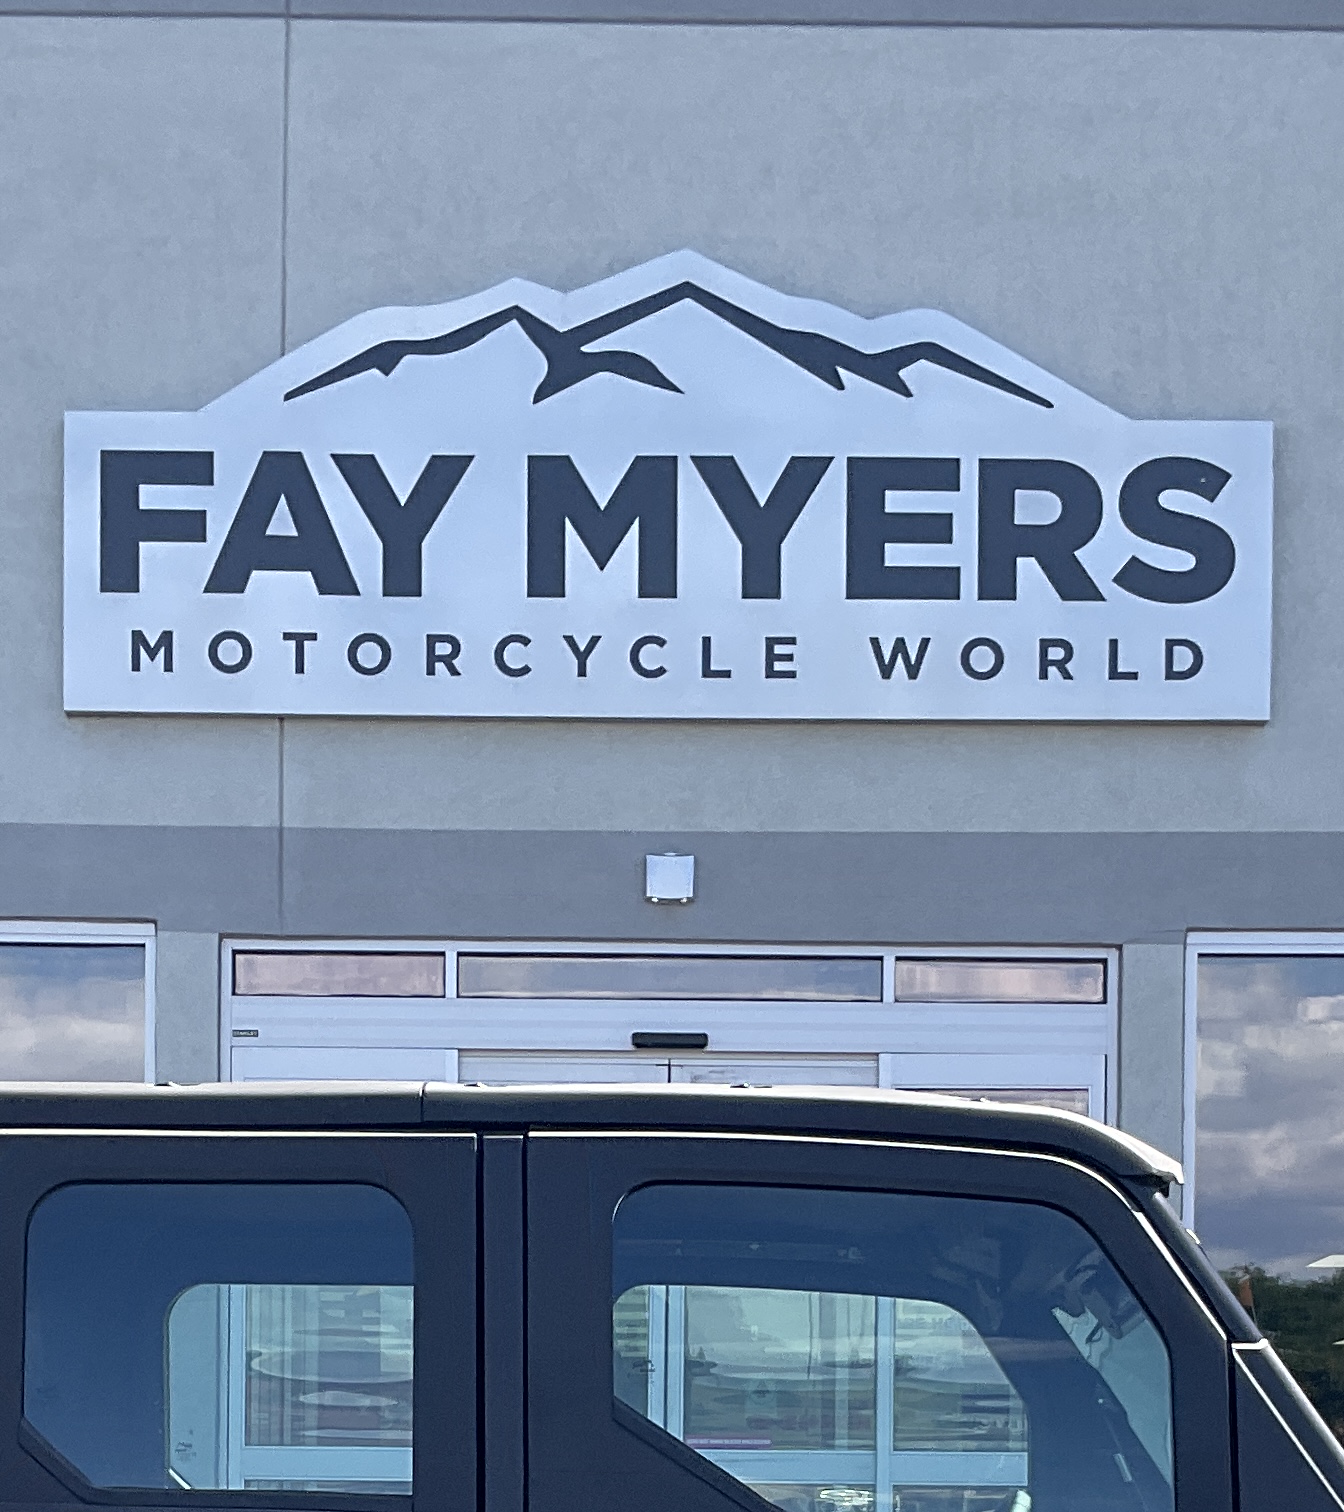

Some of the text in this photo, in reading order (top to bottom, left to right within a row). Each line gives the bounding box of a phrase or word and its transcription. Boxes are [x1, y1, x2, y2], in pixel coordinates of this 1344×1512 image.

[99, 449, 1237, 605] FAY MYERS
[130, 629, 1205, 682] MOTORCYCLE WORLD
